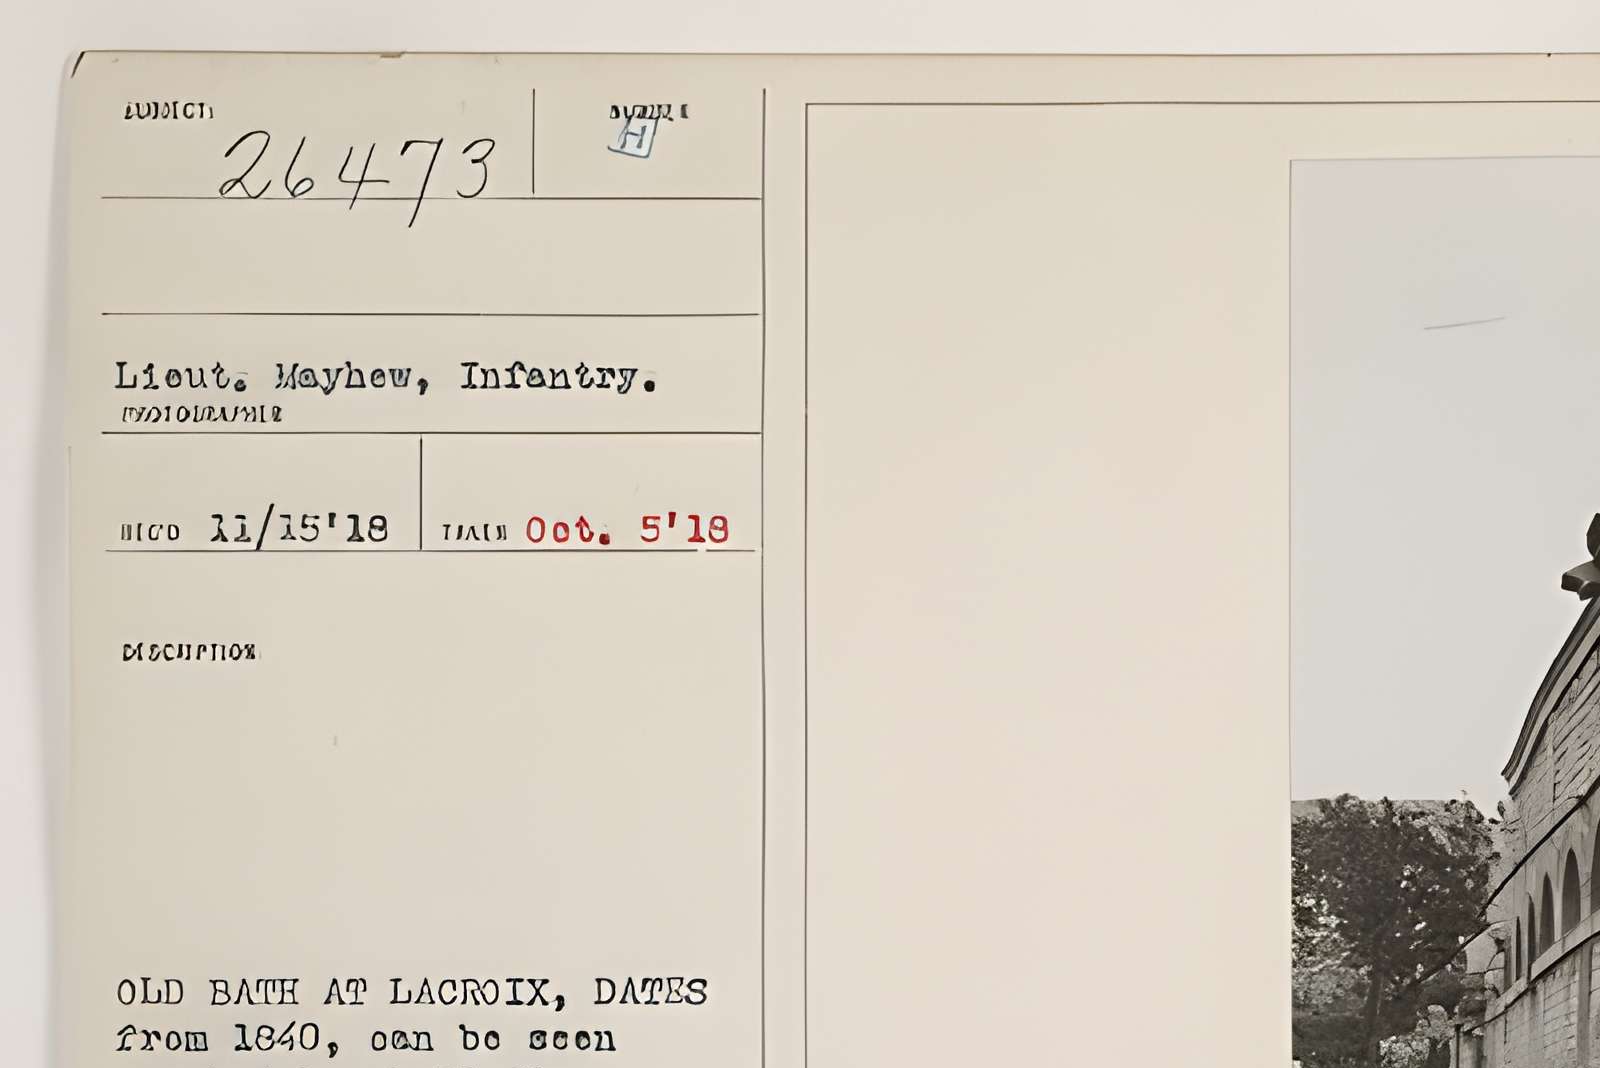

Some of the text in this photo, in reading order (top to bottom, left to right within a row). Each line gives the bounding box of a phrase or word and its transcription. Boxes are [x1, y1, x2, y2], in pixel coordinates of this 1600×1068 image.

[218, 130, 496, 228] 26473
[274, 360, 429, 396] Mayhew,
[460, 360, 656, 395] Infantry.
[210, 502, 388, 551] 11/15'18
[640, 511, 729, 544] 5'18
[116, 976, 708, 1012] OLD BATH AT LACROIX, DATES
[115, 1022, 617, 1059] from 1840, can be seen
